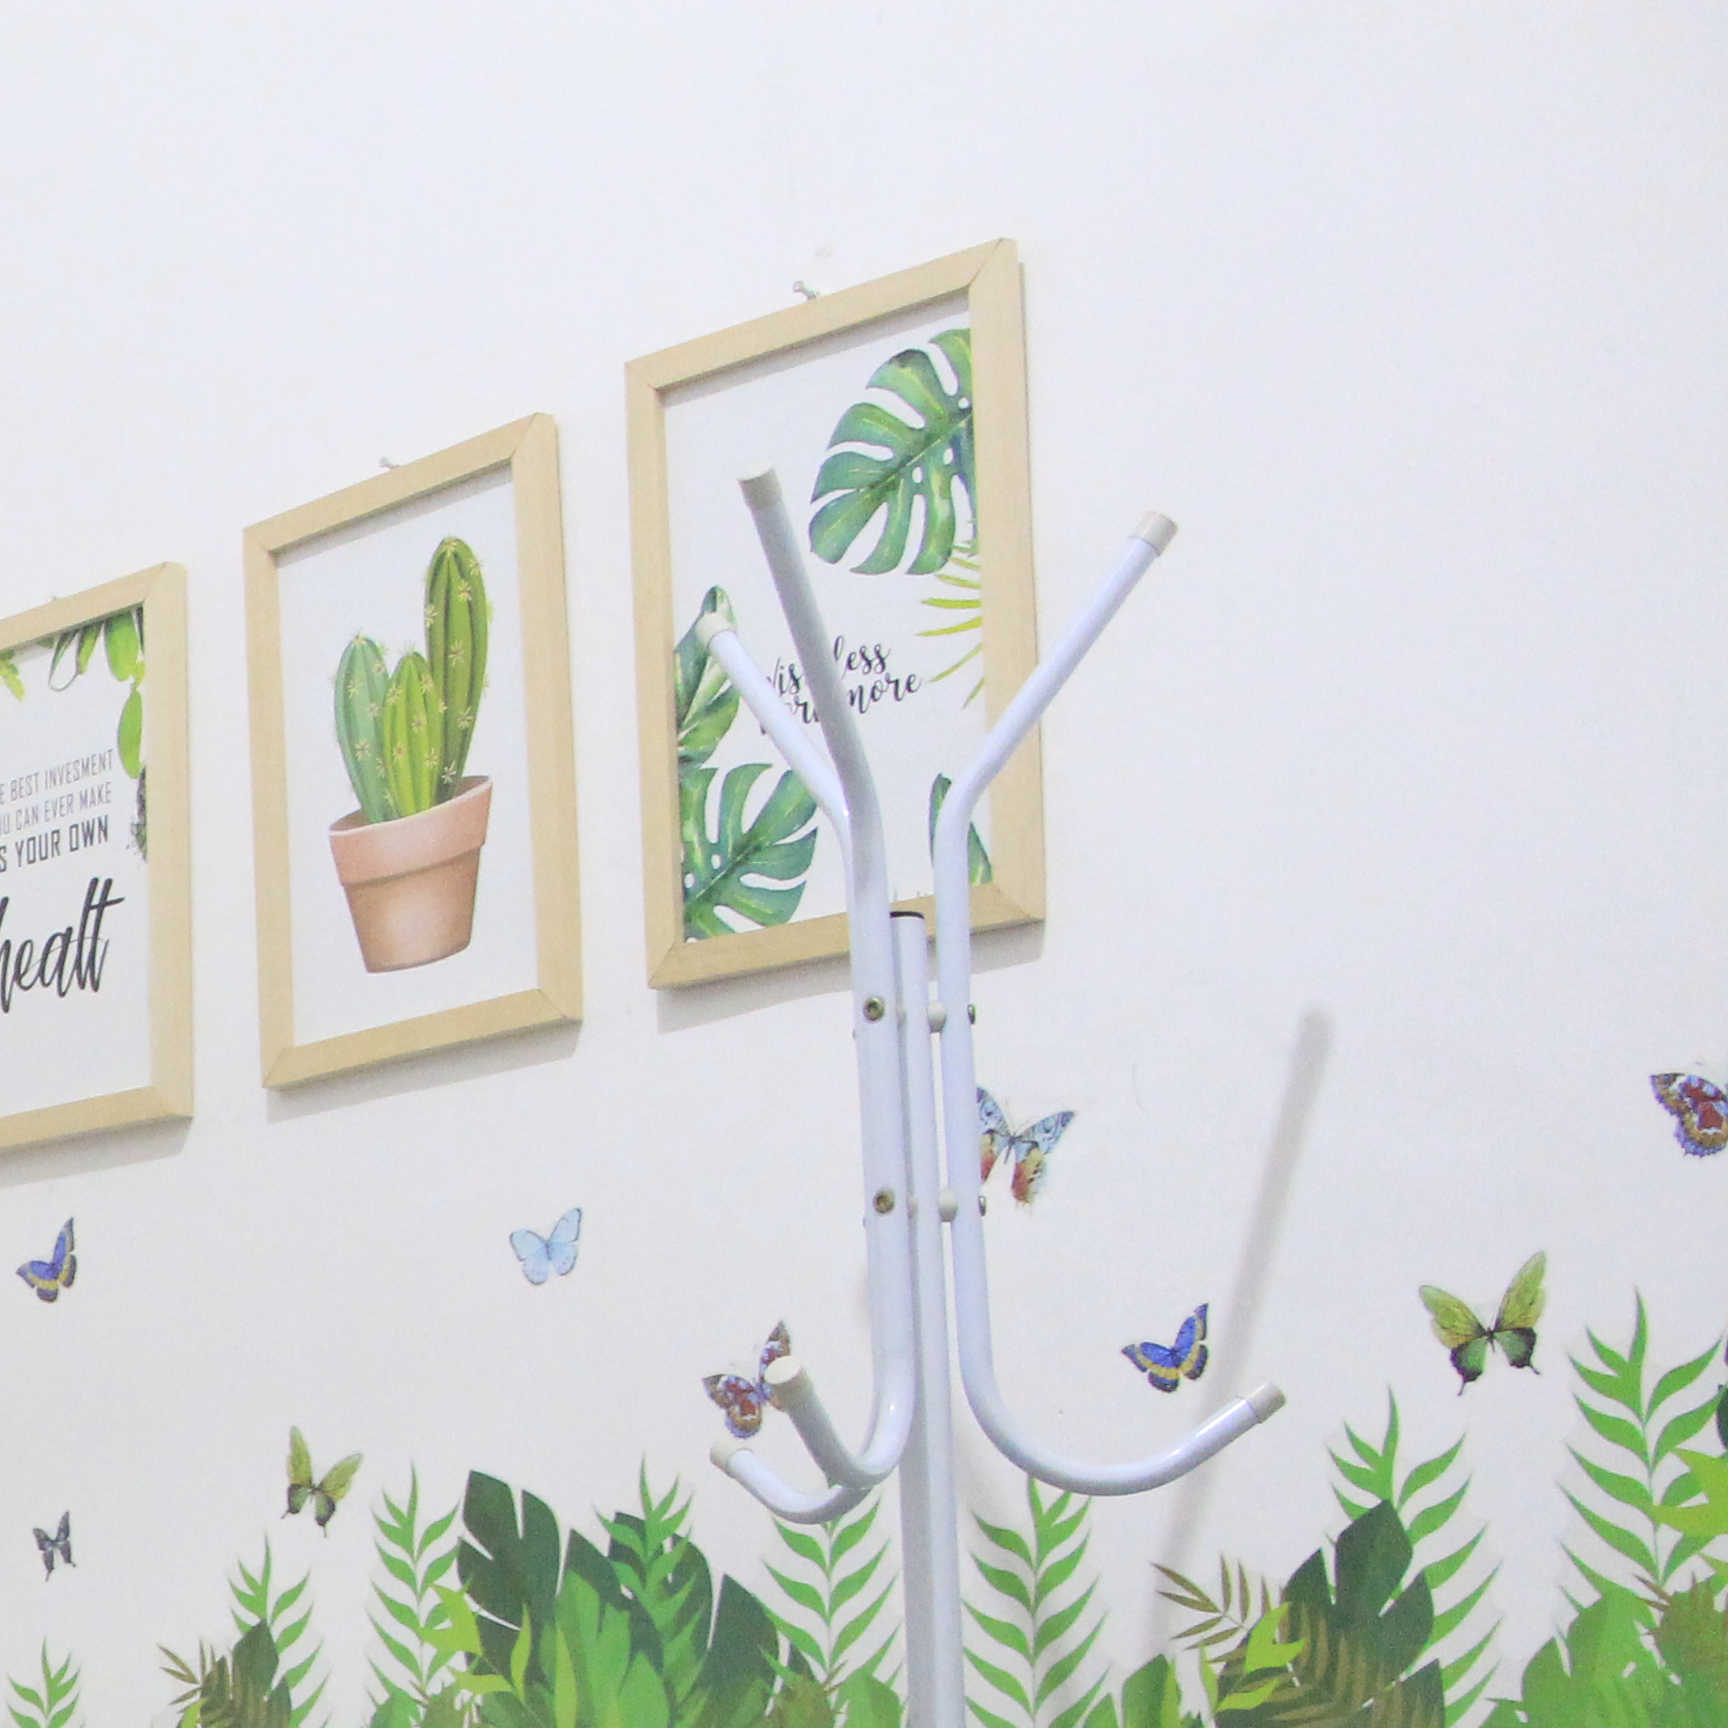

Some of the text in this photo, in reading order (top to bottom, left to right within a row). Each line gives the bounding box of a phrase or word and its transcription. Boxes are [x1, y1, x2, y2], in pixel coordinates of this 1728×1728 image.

[10, 772, 40, 802] BEST
[44, 749, 113, 790] INVESMENT
[15, 804, 39, 831] CAN
[44, 793, 74, 822] EVER
[79, 781, 112, 811] MAKE
[15, 829, 61, 868] YOUR
[69, 814, 109, 852] OWN
